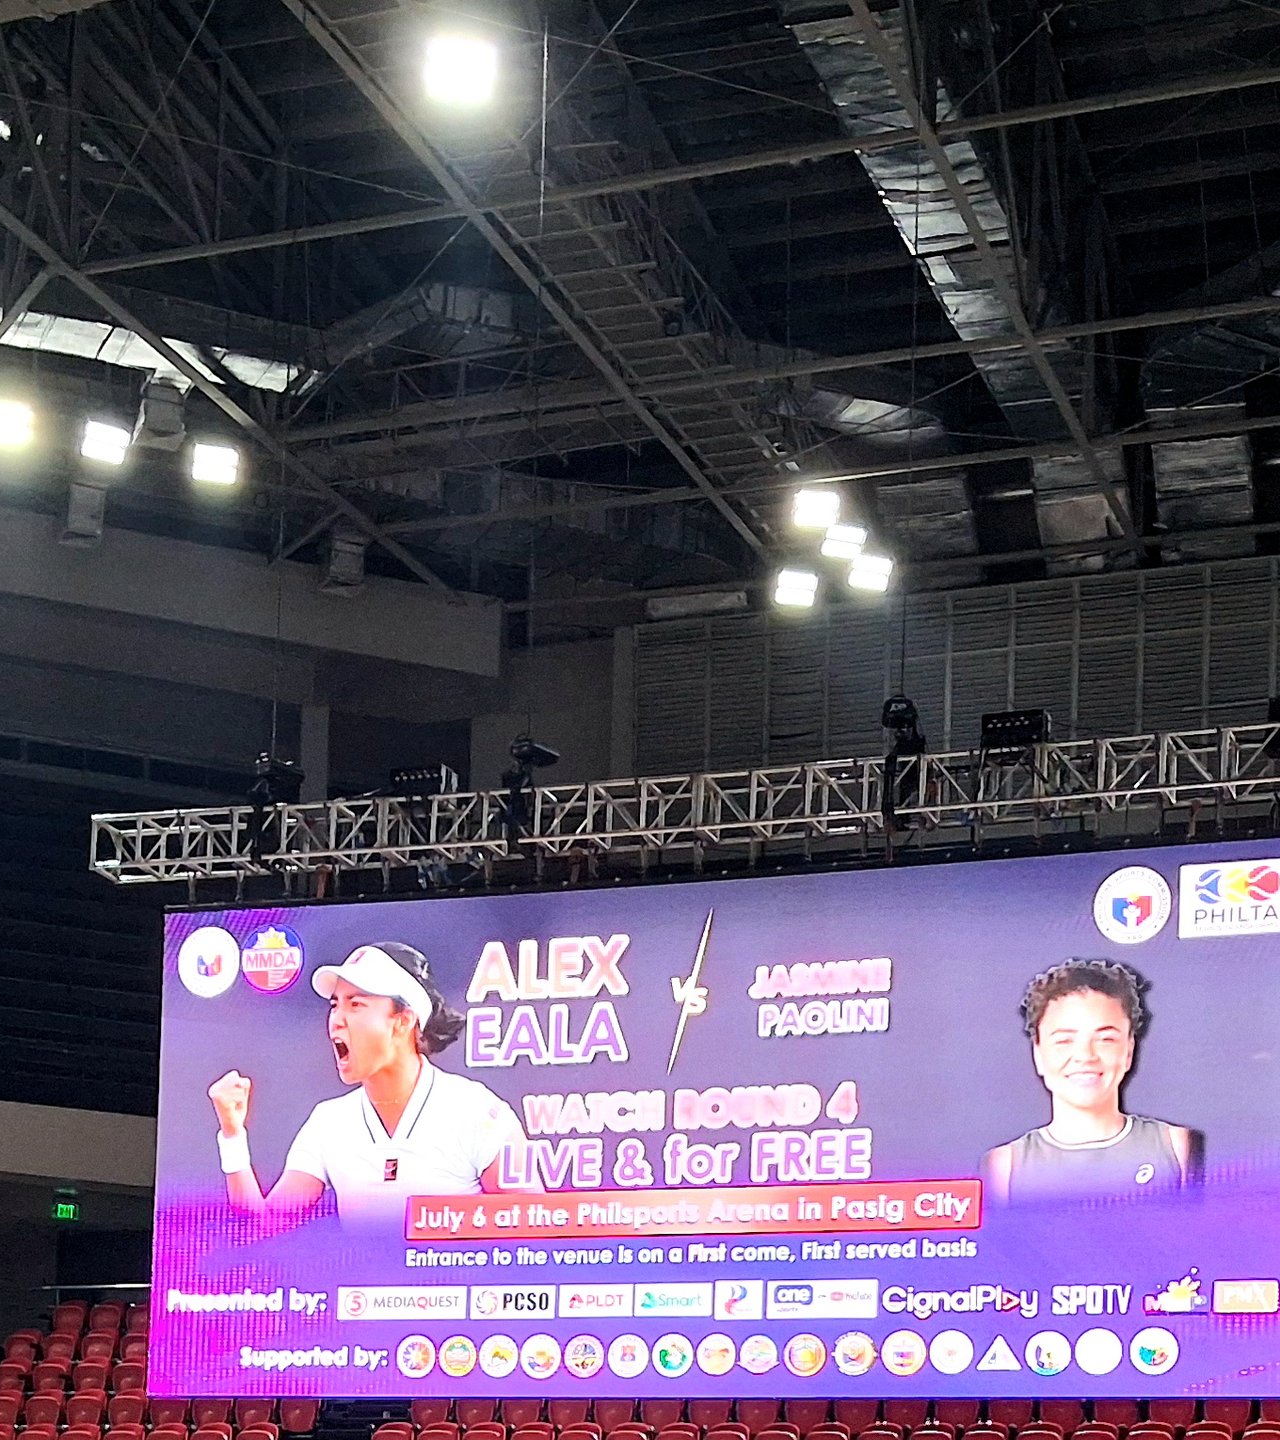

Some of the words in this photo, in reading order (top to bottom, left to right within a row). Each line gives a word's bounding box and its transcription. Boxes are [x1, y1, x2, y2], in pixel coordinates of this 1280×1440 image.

[1194, 904, 1279, 924] PHILTA
[246, 952, 297, 969] MMDA
[467, 935, 629, 1001] ALEX
[748, 958, 892, 999] JASMINE
[757, 998, 890, 1037] PAOLINI
[467, 1002, 629, 1067] EALA
[523, 1090, 665, 1134] WATCH
[673, 1084, 821, 1130] ROUND
[825, 1081, 859, 1124] 4
[498, 1137, 602, 1188] LIVE
[614, 1138, 653, 1186] &
[664, 1133, 740, 1185] for
[750, 1128, 872, 1182] FREE
[415, 1206, 464, 1232] July
[472, 1206, 486, 1228] 6
[494, 1205, 521, 1227] at
[527, 1205, 569, 1227] the
[577, 1200, 699, 1229] Philsports
[706, 1198, 789, 1222] Arena
[797, 1197, 822, 1220] in
[831, 1195, 904, 1223] Pasig
[914, 1192, 971, 1222] City
[405, 1249, 488, 1268] Entrance
[492, 1248, 511, 1266] to
[516, 1247, 547, 1265] the
[552, 1249, 613, 1265] venue
[618, 1245, 633, 1264] is
[638, 1247, 663, 1264] on
[668, 1248, 683, 1263] a
[730, 1243, 796, 1263] come,
[846, 1238, 916, 1259] served
[922, 1237, 977, 1258] basis
[289, 1287, 328, 1315] by:
[373, 1295, 460, 1310] MEDIAQUEST
[502, 1292, 549, 1311] PCSO
[586, 1294, 624, 1308] PLDT
[659, 1293, 703, 1307] Smart
[777, 1288, 810, 1302] one
[1051, 1284, 1132, 1316] SPOTV
[239, 1345, 349, 1372] Supported
[353, 1345, 389, 1371] by:
